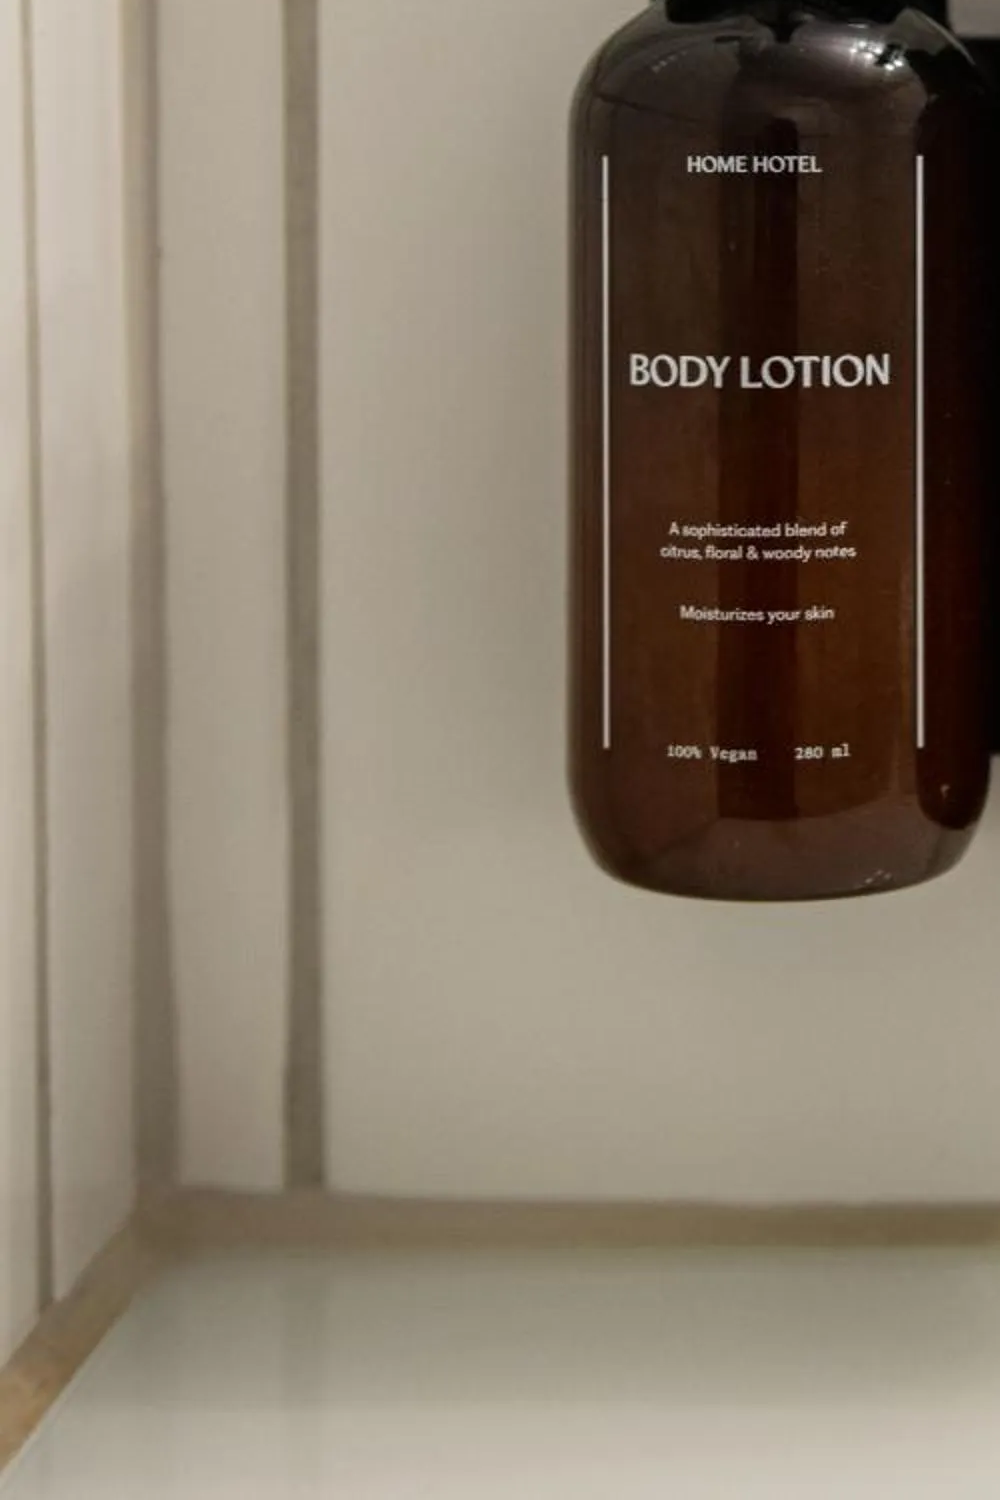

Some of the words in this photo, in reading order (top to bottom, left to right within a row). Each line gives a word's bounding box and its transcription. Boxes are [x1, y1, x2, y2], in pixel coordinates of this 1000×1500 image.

[686, 154, 749, 174] HOME
[751, 154, 824, 174] HOTEL
[629, 352, 732, 389] BODY
[739, 352, 891, 389] LOTION
[668, 521, 681, 537] A
[681, 521, 783, 541] sophisticated
[783, 521, 829, 538] blend
[828, 520, 849, 537] of
[659, 543, 704, 561] citrus,
[703, 543, 744, 561] floral
[745, 544, 760, 561] &
[761, 543, 813, 564] woody
[813, 544, 858, 560] notes
[679, 604, 766, 623] Moisturizes
[766, 609, 802, 626] your
[803, 604, 836, 622] skin
[666, 744, 703, 760] 100%
[708, 745, 758, 764] Vegan
[793, 745, 825, 761] 280
[830, 742, 851, 759] ml
